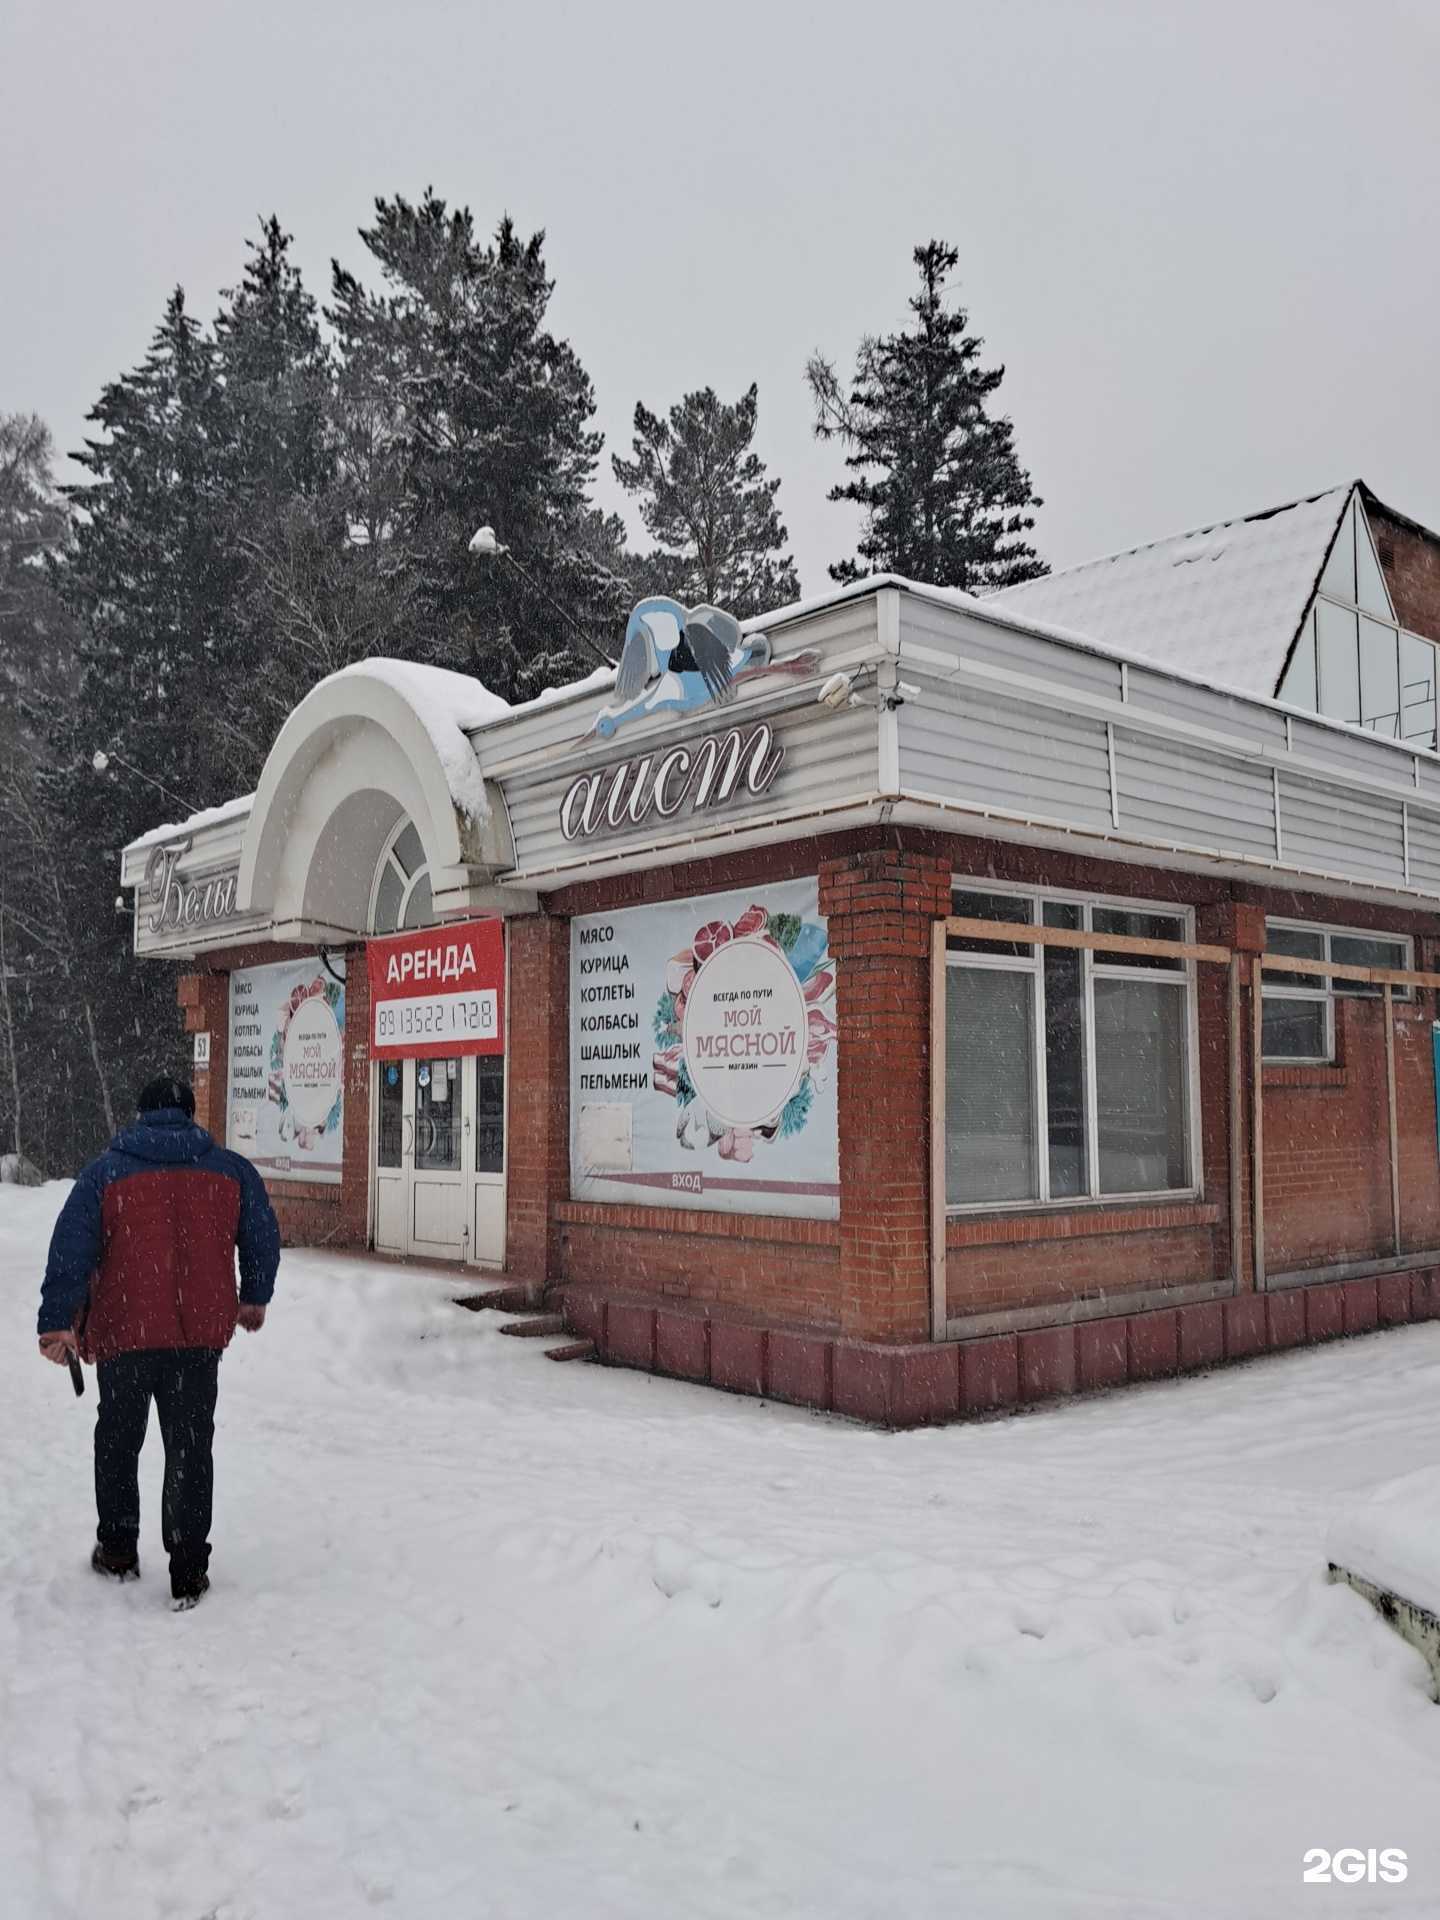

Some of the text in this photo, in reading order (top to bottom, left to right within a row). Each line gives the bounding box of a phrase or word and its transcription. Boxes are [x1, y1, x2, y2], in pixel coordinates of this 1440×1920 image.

[144, 721, 785, 934] Белы аист
[580, 926, 614, 945] МЯСО
[386, 943, 476, 984] АРЕНДА
[580, 954, 630, 975] КУРИЦА
[234, 982, 253, 995] МЯСО
[580, 983, 635, 1004] КОТЛЕТЫ
[713, 988, 773, 1003] ВСЕГДА ПО ПУТИ
[234, 1003, 260, 1017] КУРИЦА
[379, 1000, 492, 1036] 89135221728
[724, 1004, 762, 1027] МОЙ
[234, 1024, 262, 1038] КОТЛЕТЫ
[580, 1012, 639, 1033] КОЛБАСЫ
[303, 1042, 321, 1059] МОЙ
[696, 1025, 796, 1058] МЯСНОЙ
[234, 1044, 263, 1058] КОЛБАСЫ
[580, 1043, 641, 1061] ШАШЛЫК
[233, 1066, 263, 1079] ШАШЛЫК
[289, 1057, 337, 1080] МЯСНОЙ
[728, 1063, 758, 1071] магазин
[580, 1073, 648, 1090] ПЕЛЬМЕНИ
[232, 1087, 267, 1100] ПЕЛЬМЕНИ
[672, 1173, 701, 1192] ВХОД
